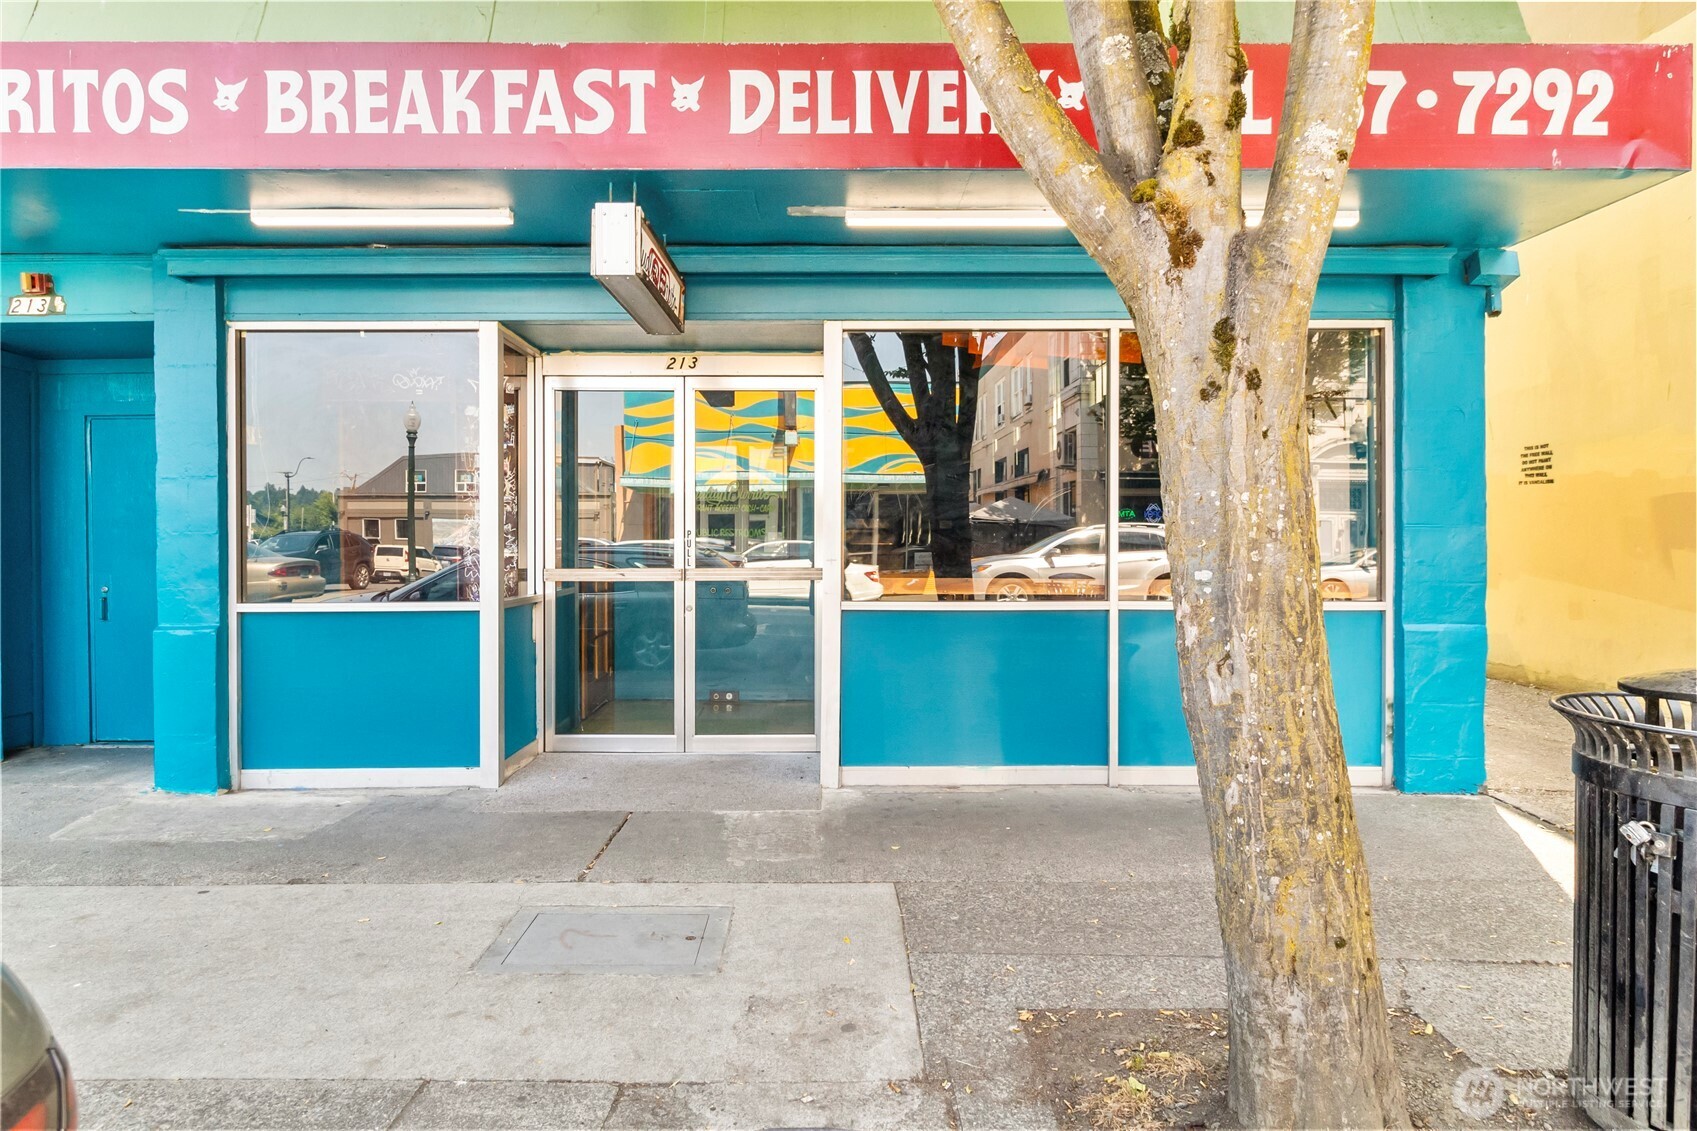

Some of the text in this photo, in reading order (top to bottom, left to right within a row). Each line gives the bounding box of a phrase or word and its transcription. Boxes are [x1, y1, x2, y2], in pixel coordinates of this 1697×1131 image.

[263, 68, 656, 135] BREAKFAST
[728, 69, 1054, 135] DELIVER
[11, 298, 48, 313] 213
[666, 356, 698, 370] 213
[697, 528, 719, 537] UBLIC
